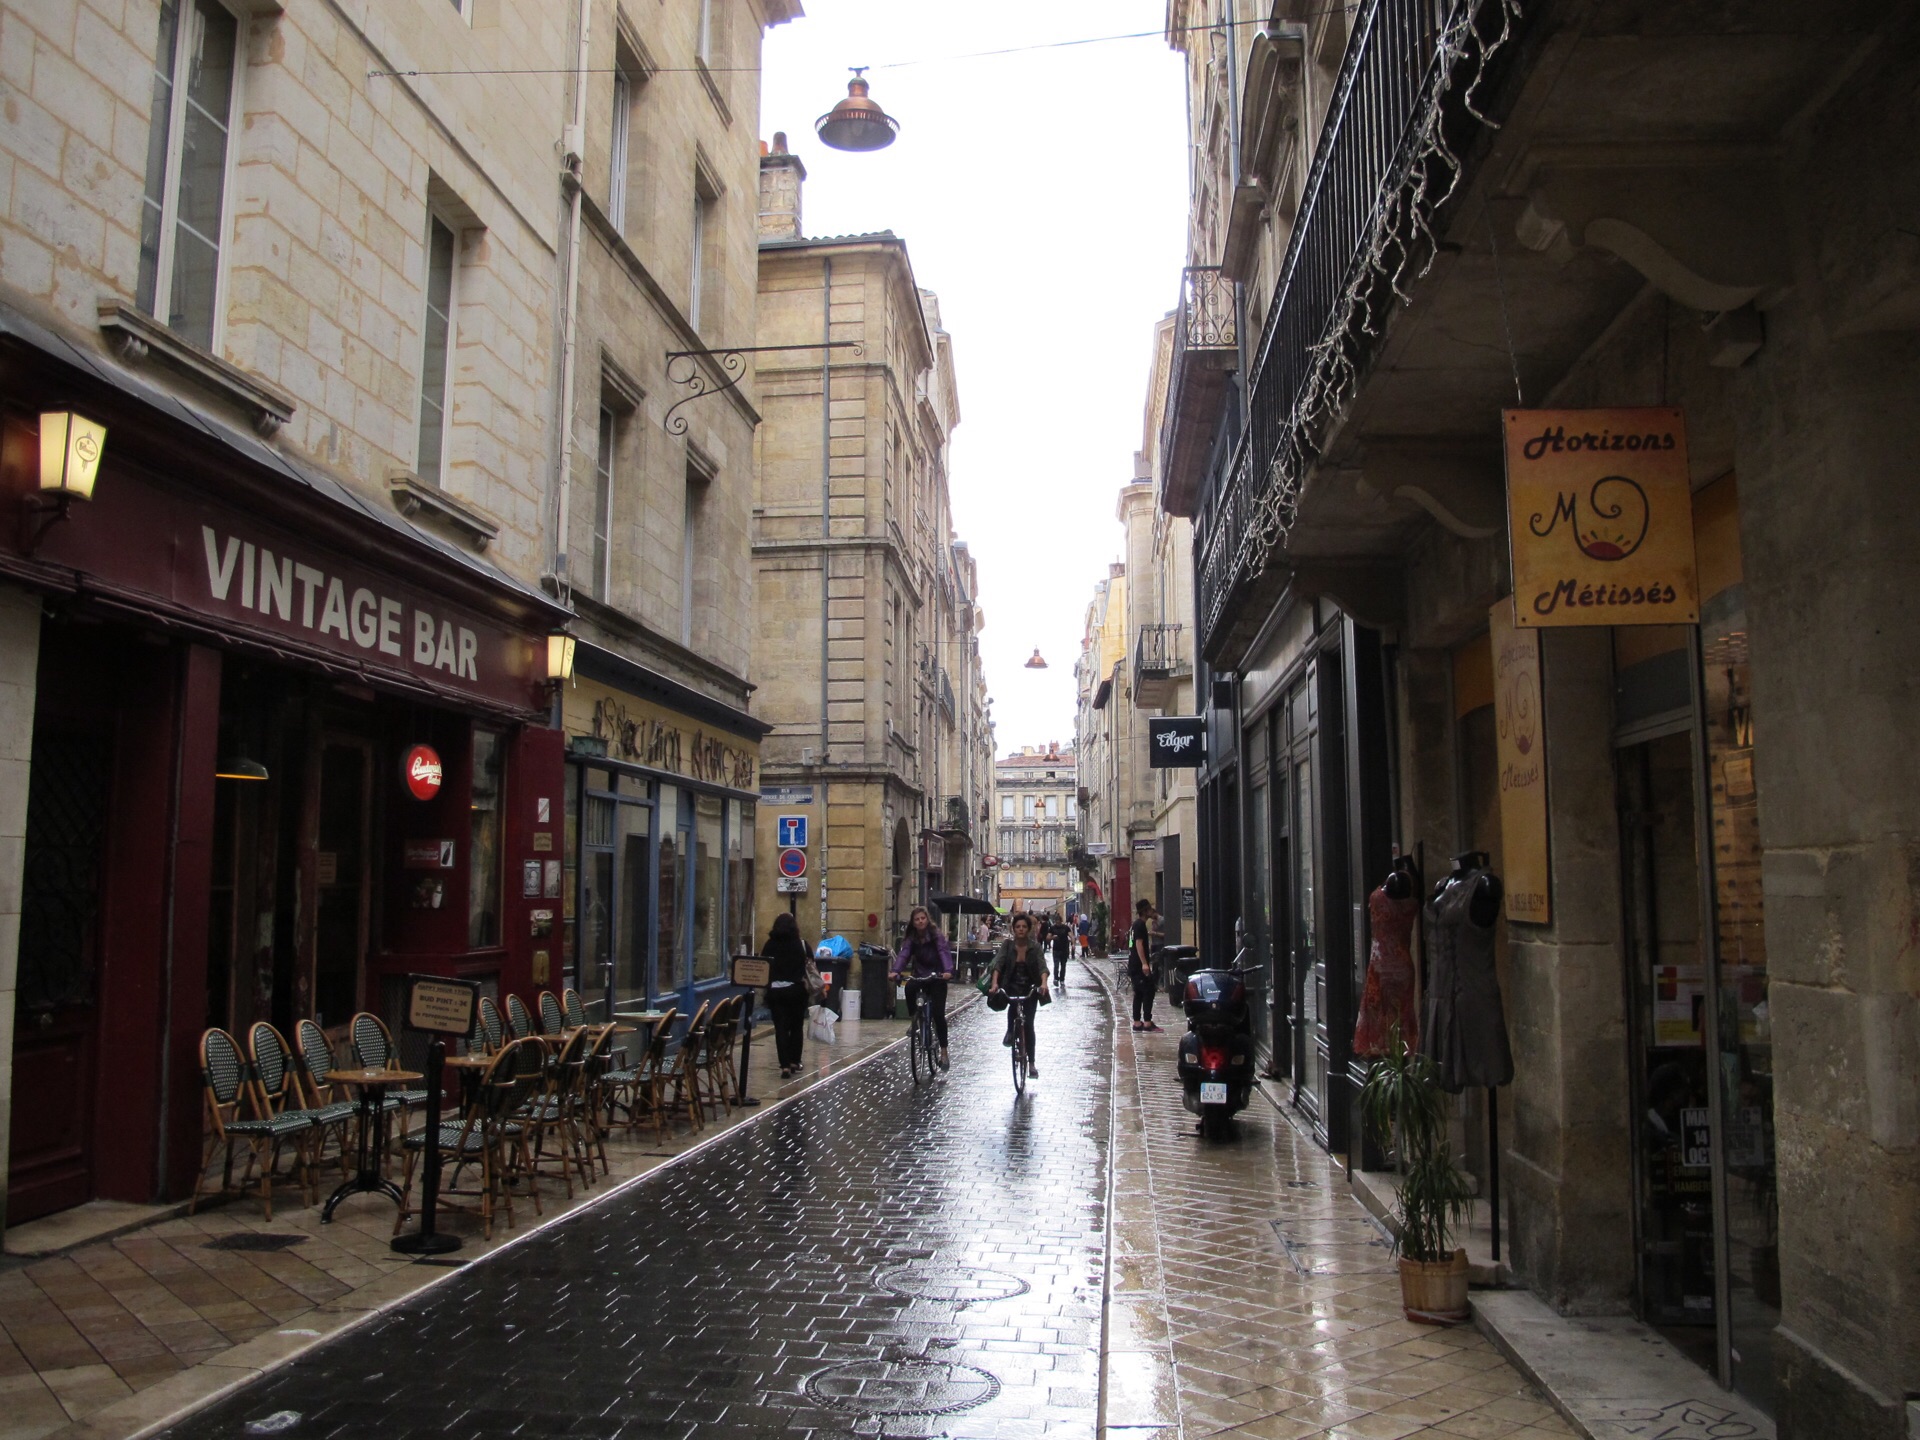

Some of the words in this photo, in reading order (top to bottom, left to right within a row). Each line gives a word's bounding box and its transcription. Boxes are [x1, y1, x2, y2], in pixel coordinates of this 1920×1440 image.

[1523, 425, 1676, 460] Horizons
[201, 524, 403, 657] VINTAGE
[413, 608, 478, 682] BAR
[1533, 578, 1677, 616] Métissés
[1156, 730, 1195, 753] Edgar
[1694, 1129, 1708, 1145] 14
